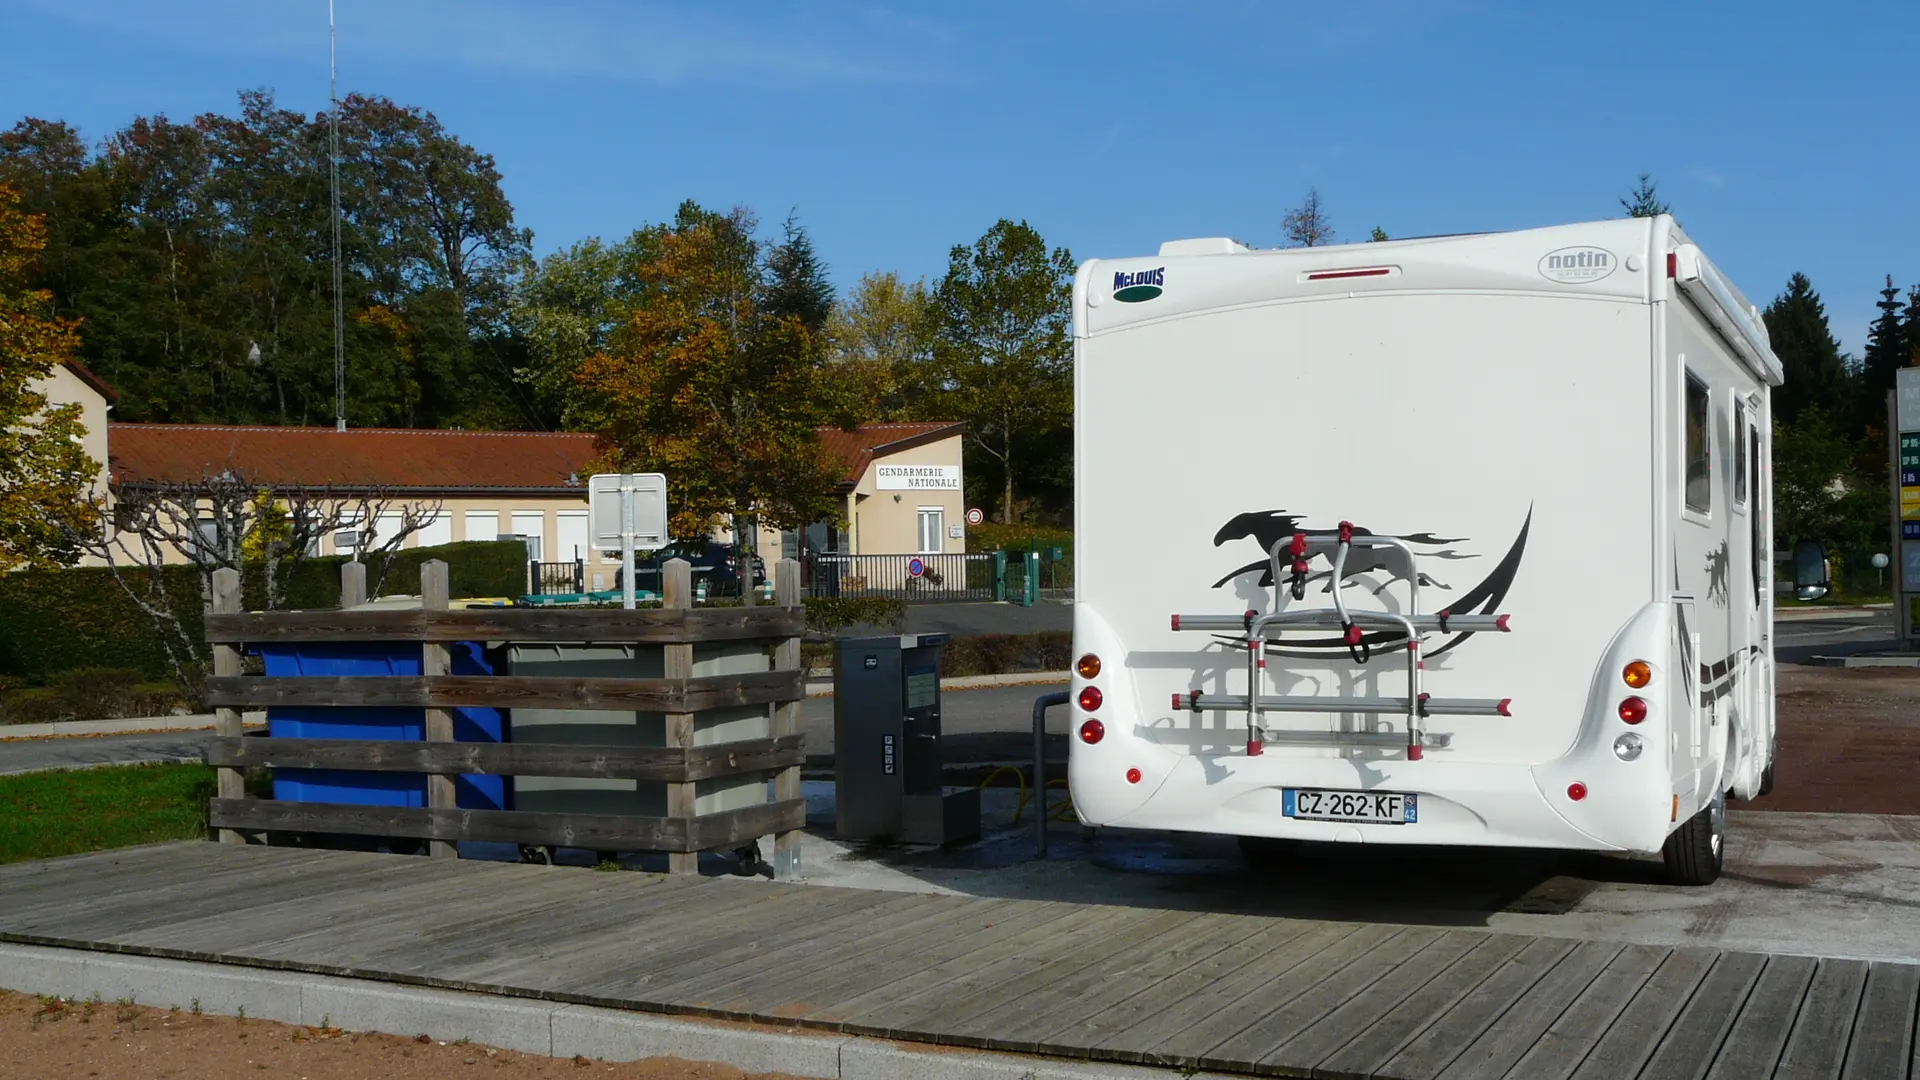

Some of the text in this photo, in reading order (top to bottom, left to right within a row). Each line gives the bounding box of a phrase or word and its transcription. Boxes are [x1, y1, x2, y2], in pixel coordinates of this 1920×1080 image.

[1548, 251, 1608, 269] notin
[879, 468, 943, 477] GENDARMERIE
[908, 478, 957, 488] NATIONALE
[1297, 792, 1401, 818] CZ-262-KF
[1404, 809, 1416, 820] 42
